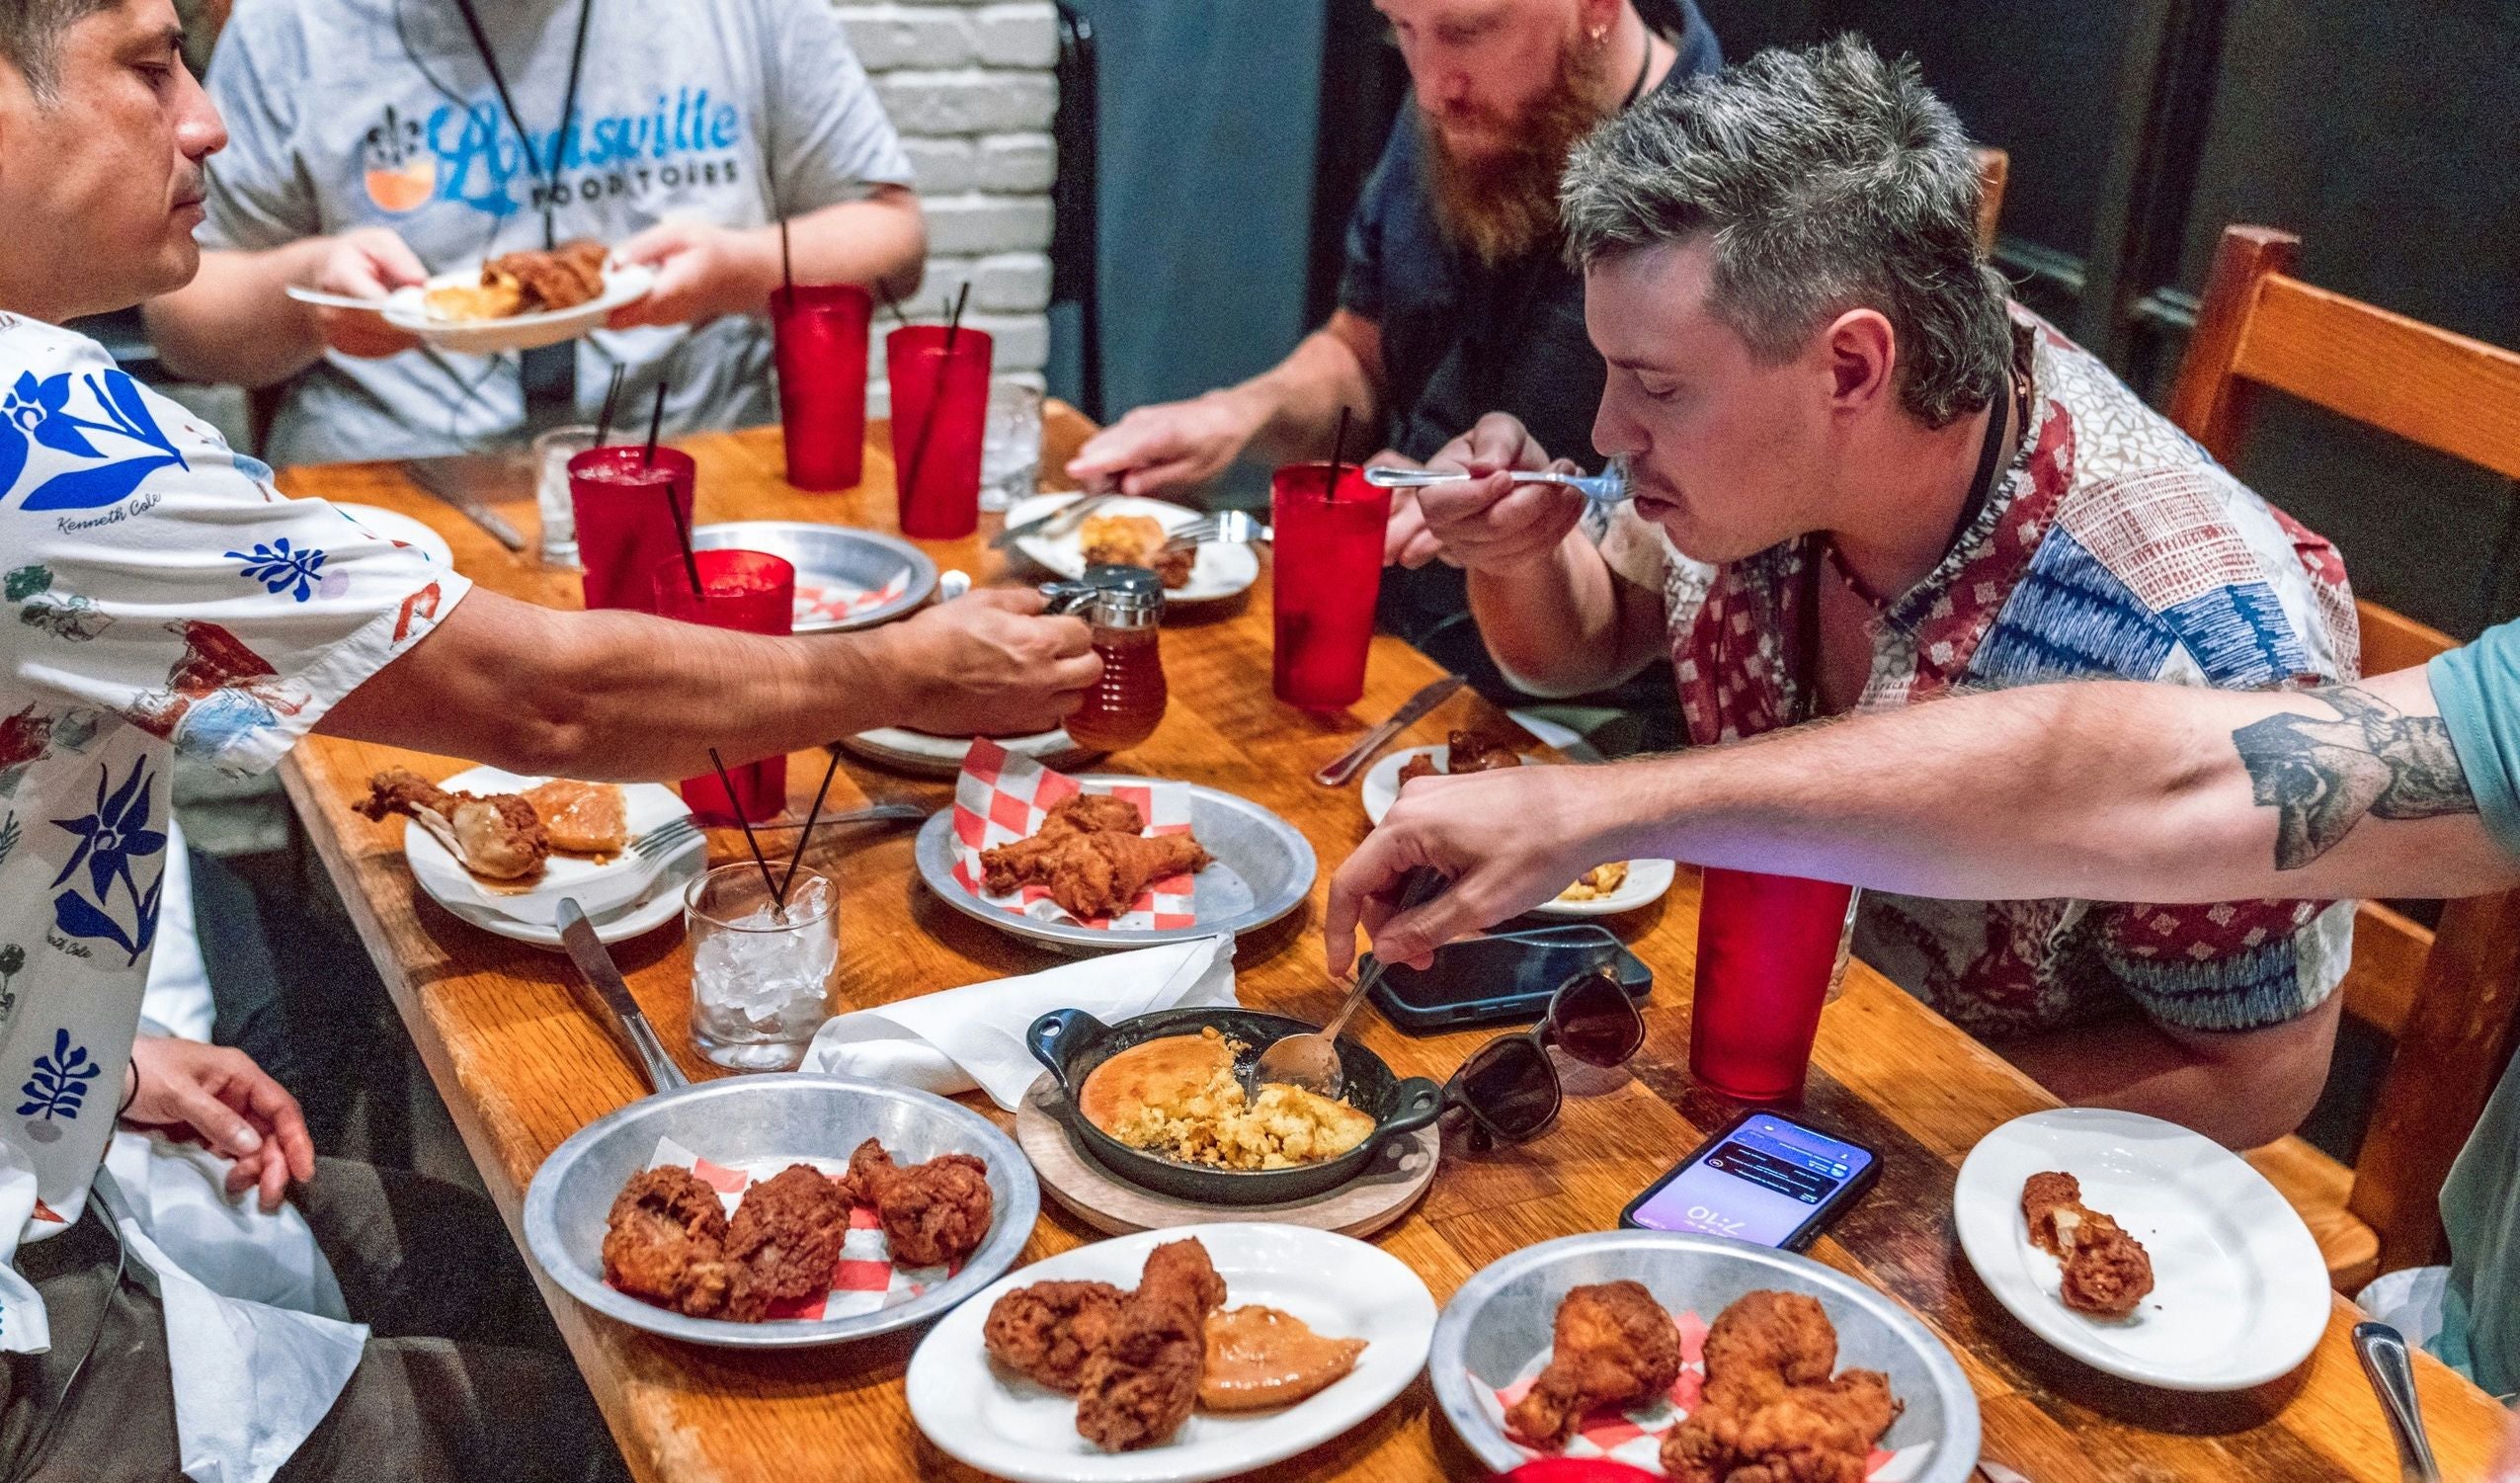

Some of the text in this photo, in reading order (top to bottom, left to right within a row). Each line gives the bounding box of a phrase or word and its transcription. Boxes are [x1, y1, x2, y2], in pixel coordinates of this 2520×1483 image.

[57, 493, 162, 536] Kenneth Cole
[1687, 1204, 1747, 1236] 7:10
